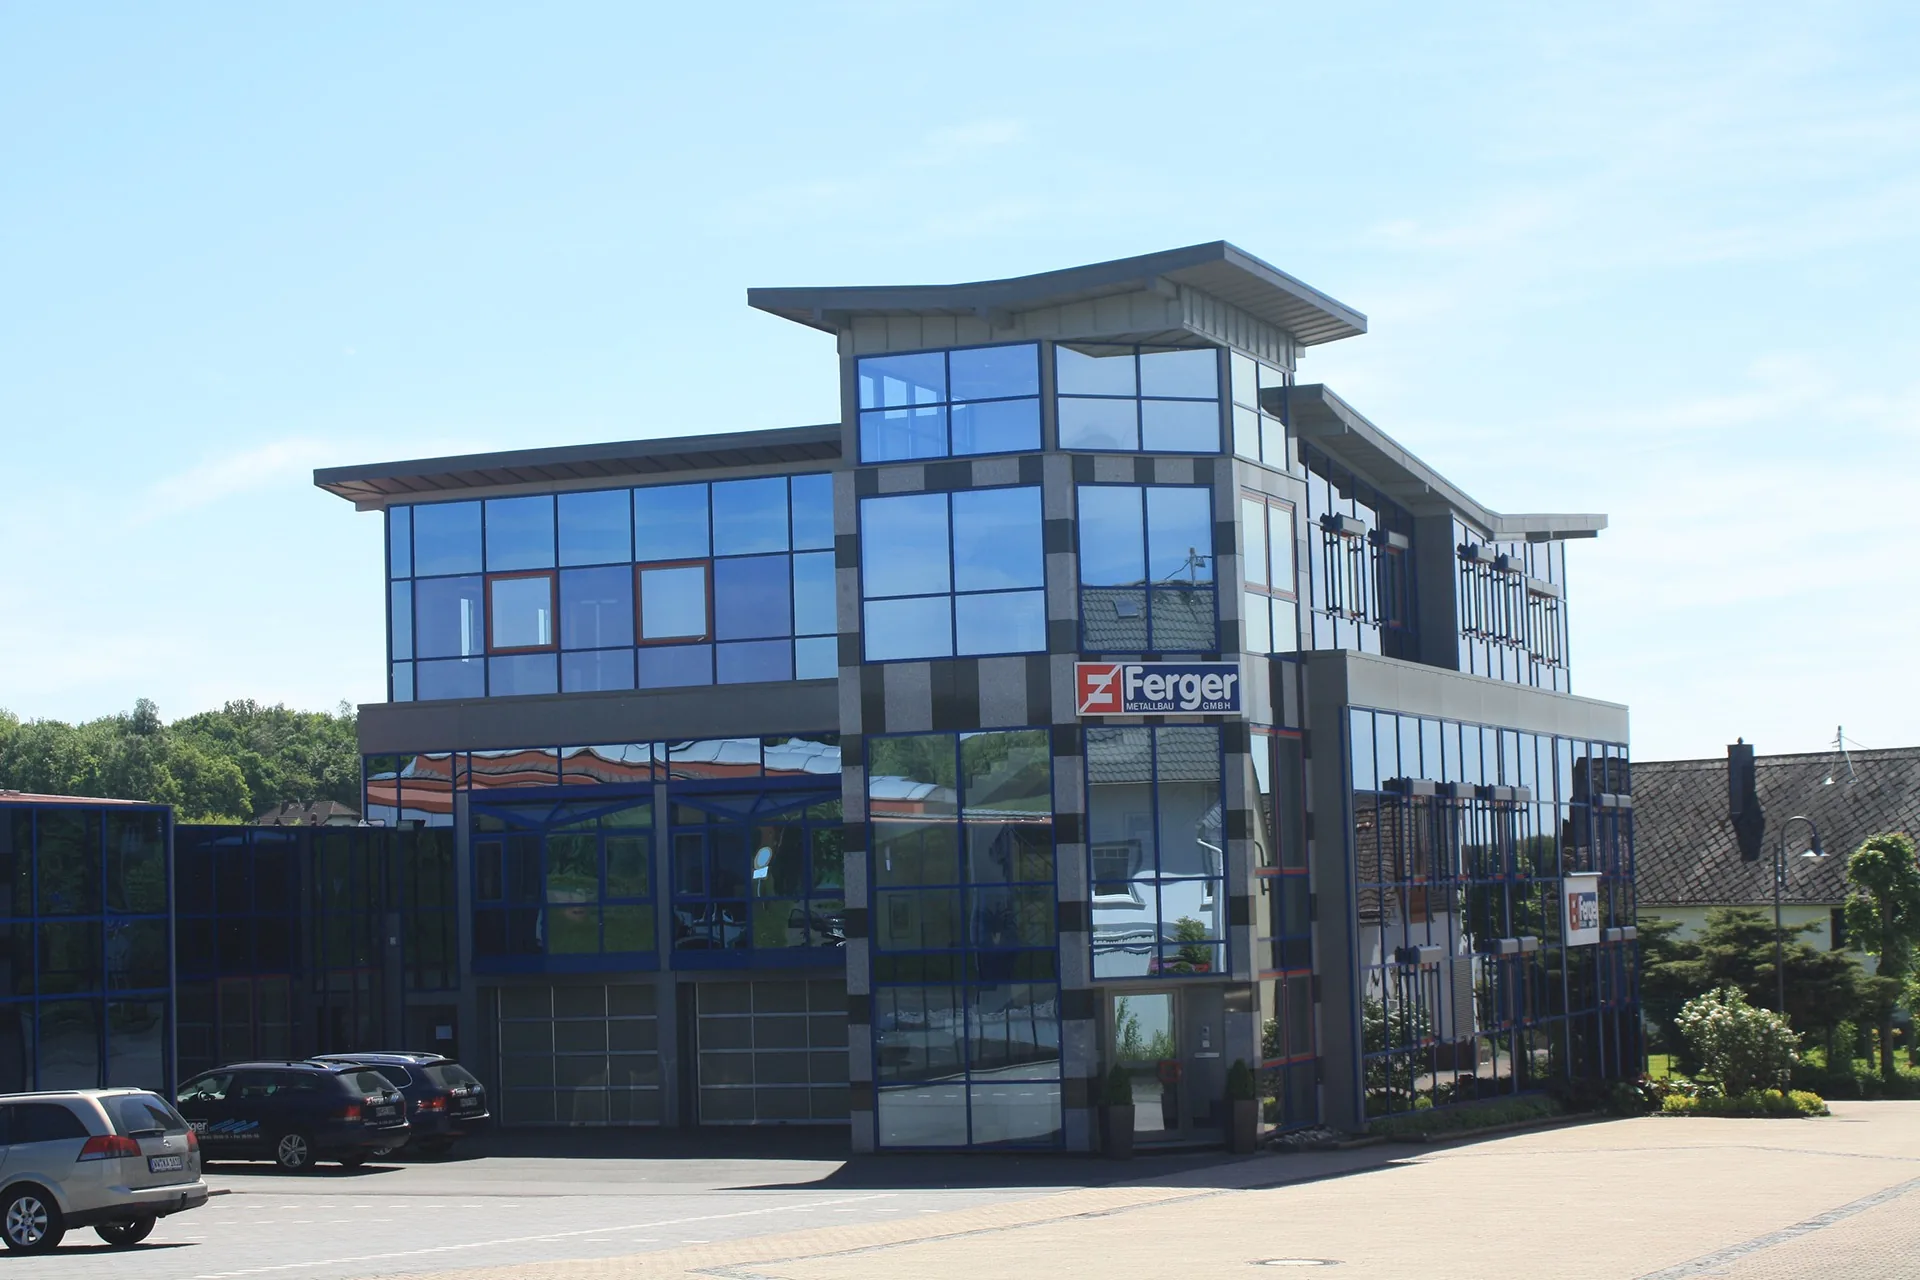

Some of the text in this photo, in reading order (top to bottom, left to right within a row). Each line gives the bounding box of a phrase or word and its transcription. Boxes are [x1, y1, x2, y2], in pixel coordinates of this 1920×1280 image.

[1126, 666, 1237, 710] Ferger
[1126, 702, 1231, 711] METALLBAU GMBH
